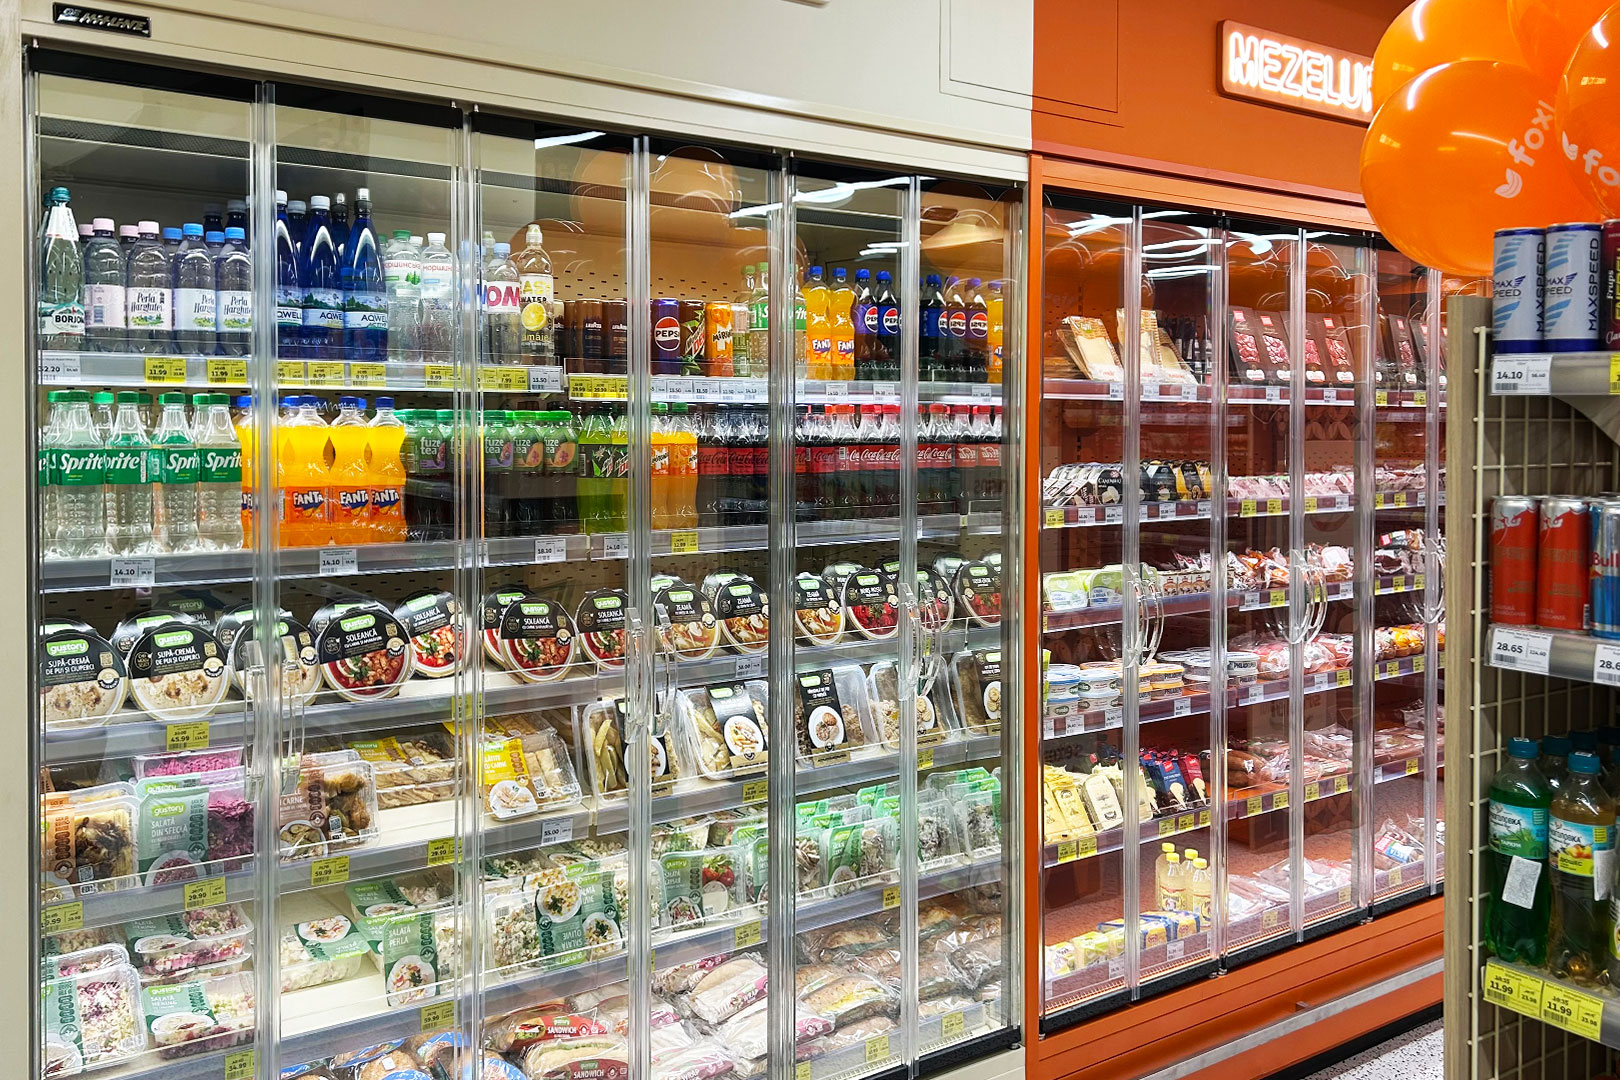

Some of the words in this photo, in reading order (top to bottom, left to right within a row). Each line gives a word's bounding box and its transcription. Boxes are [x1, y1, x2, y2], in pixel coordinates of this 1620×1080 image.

[1588, 237, 1599, 331] MAXSPEED
[1606, 269, 1616, 300] Frups
[1494, 289, 1522, 298] PEED
[1545, 286, 1573, 295] PEED
[1496, 371, 1523, 379] 14.10
[485, 437, 504, 448] fuze
[485, 446, 500, 454] tea
[59, 450, 104, 474] Sprite
[293, 491, 323, 506] FANTA
[114, 568, 135, 576] 14.10
[344, 616, 373, 631] gustory
[158, 634, 191, 646] gustory
[49, 643, 86, 655] gustory
[1496, 642, 1523, 654] 28.65
[154, 804, 184, 817] gustory
[151, 818, 175, 829] SALATĂ
[1490, 980, 1514, 995] 11.99
[1547, 1001, 1572, 1017] 11.99
[547, 1026, 577, 1034] SANDWICH
[573, 1069, 605, 1078] SANDWICH
